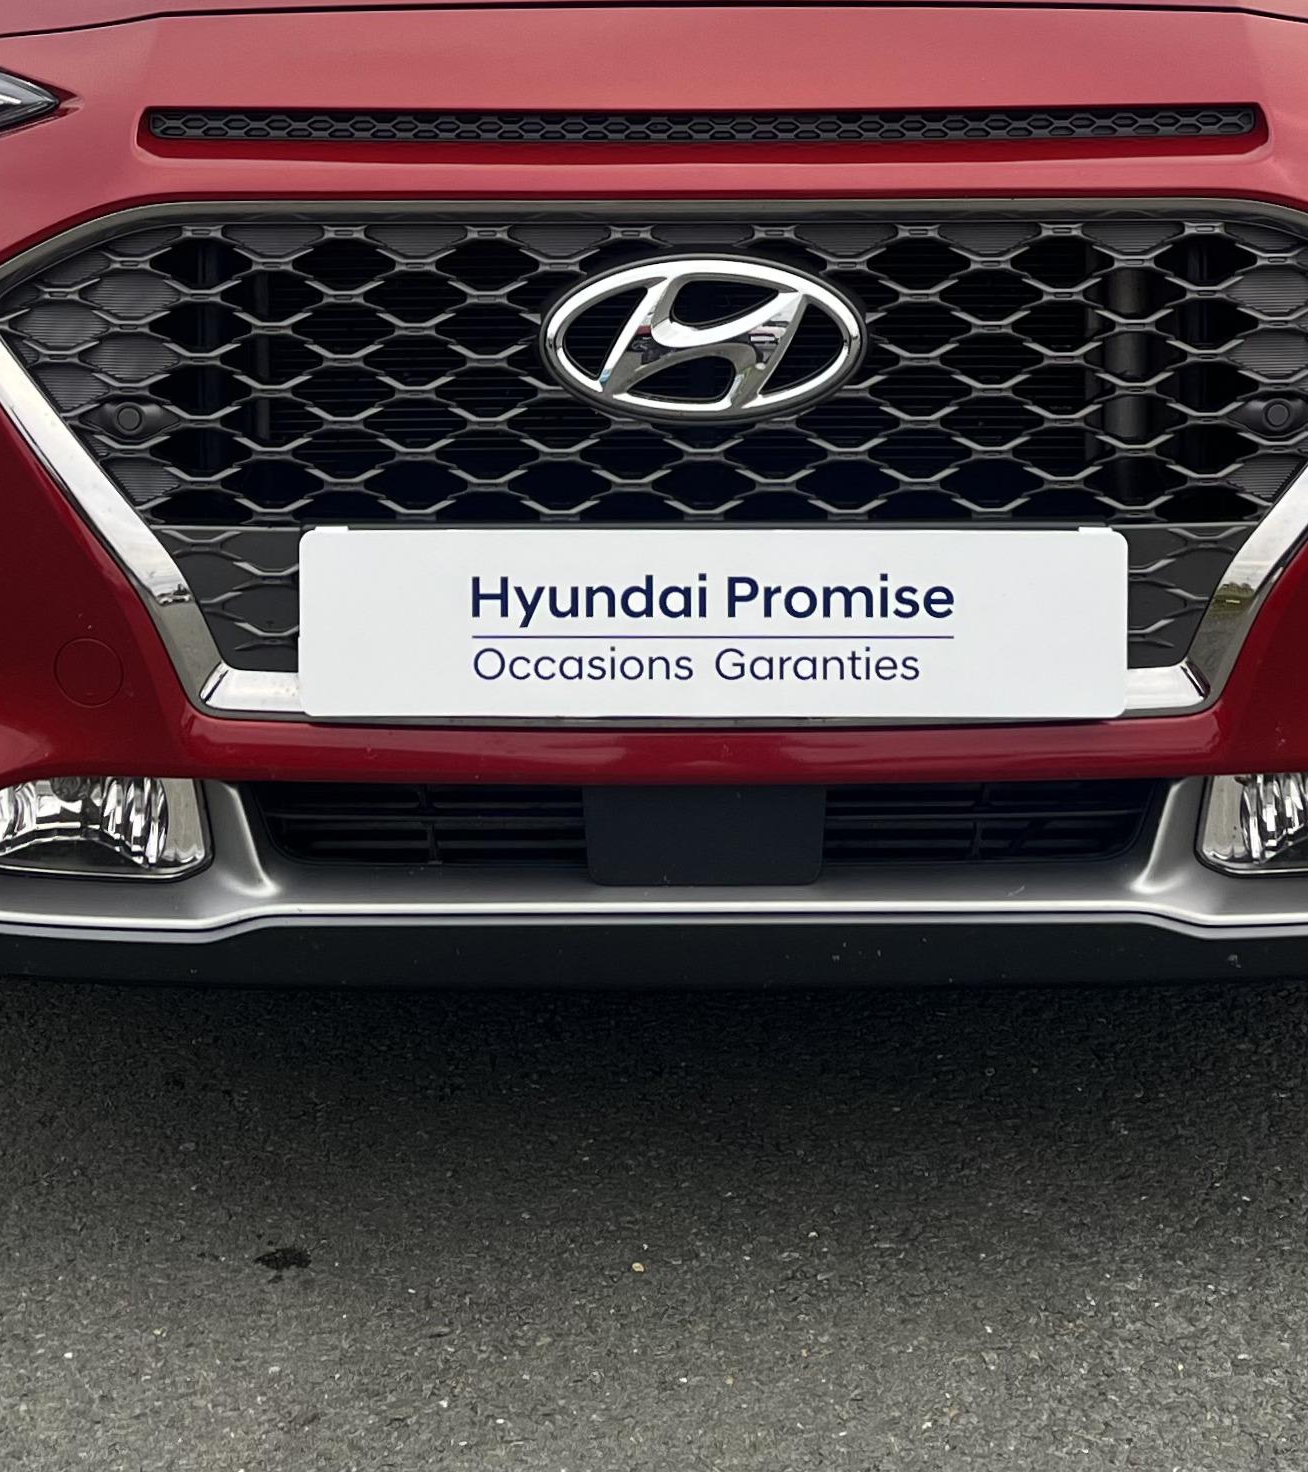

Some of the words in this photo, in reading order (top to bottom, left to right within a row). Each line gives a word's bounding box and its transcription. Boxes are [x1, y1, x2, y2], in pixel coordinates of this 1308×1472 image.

[471, 573, 707, 629] Hyundai
[727, 573, 955, 619] Promise
[473, 646, 694, 681] Occasions
[715, 646, 920, 681] Garanties
